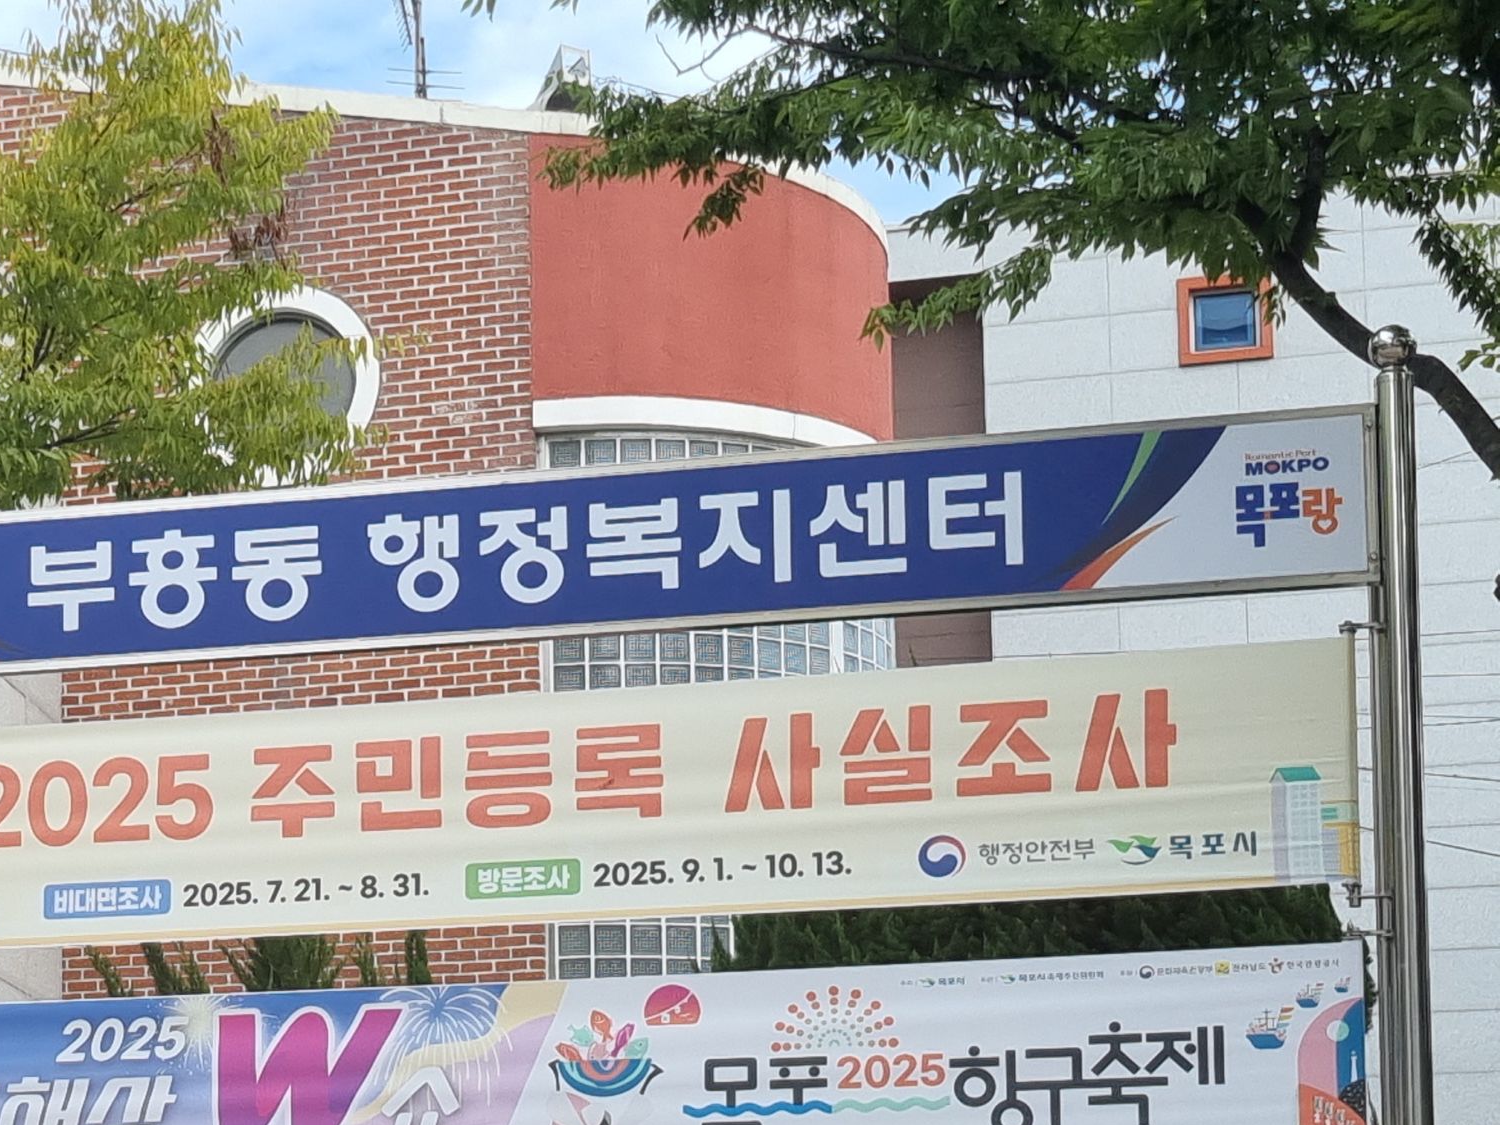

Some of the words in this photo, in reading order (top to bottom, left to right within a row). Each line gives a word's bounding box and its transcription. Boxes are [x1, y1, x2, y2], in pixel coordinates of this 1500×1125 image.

[1245, 456, 1329, 476] MOKPO
[1235, 482, 1343, 548] 목포랑
[27, 525, 323, 632] 부흥동
[367, 470, 1024, 613] 행정복지센터
[250, 722, 664, 839] 주민등록
[724, 688, 1178, 814] 사실조사
[977, 836, 1097, 867] 행정안전부
[1168, 830, 1259, 861] 목포시
[477, 864, 571, 894] 방문조사
[593, 858, 674, 889] 2025.
[682, 856, 707, 885] 9.
[711, 856, 734, 883] 1.
[764, 853, 805, 882] 10.
[811, 850, 853, 879] 13.
[52, 885, 163, 916] 비대면조사
[183, 881, 255, 910] 2025.
[266, 880, 288, 906] 7.
[293, 877, 331, 904] 21.
[359, 874, 387, 901] 8.
[392, 872, 431, 899] 31.
[55, 1015, 189, 1064] 2025
[837, 1053, 946, 1090] 2025
